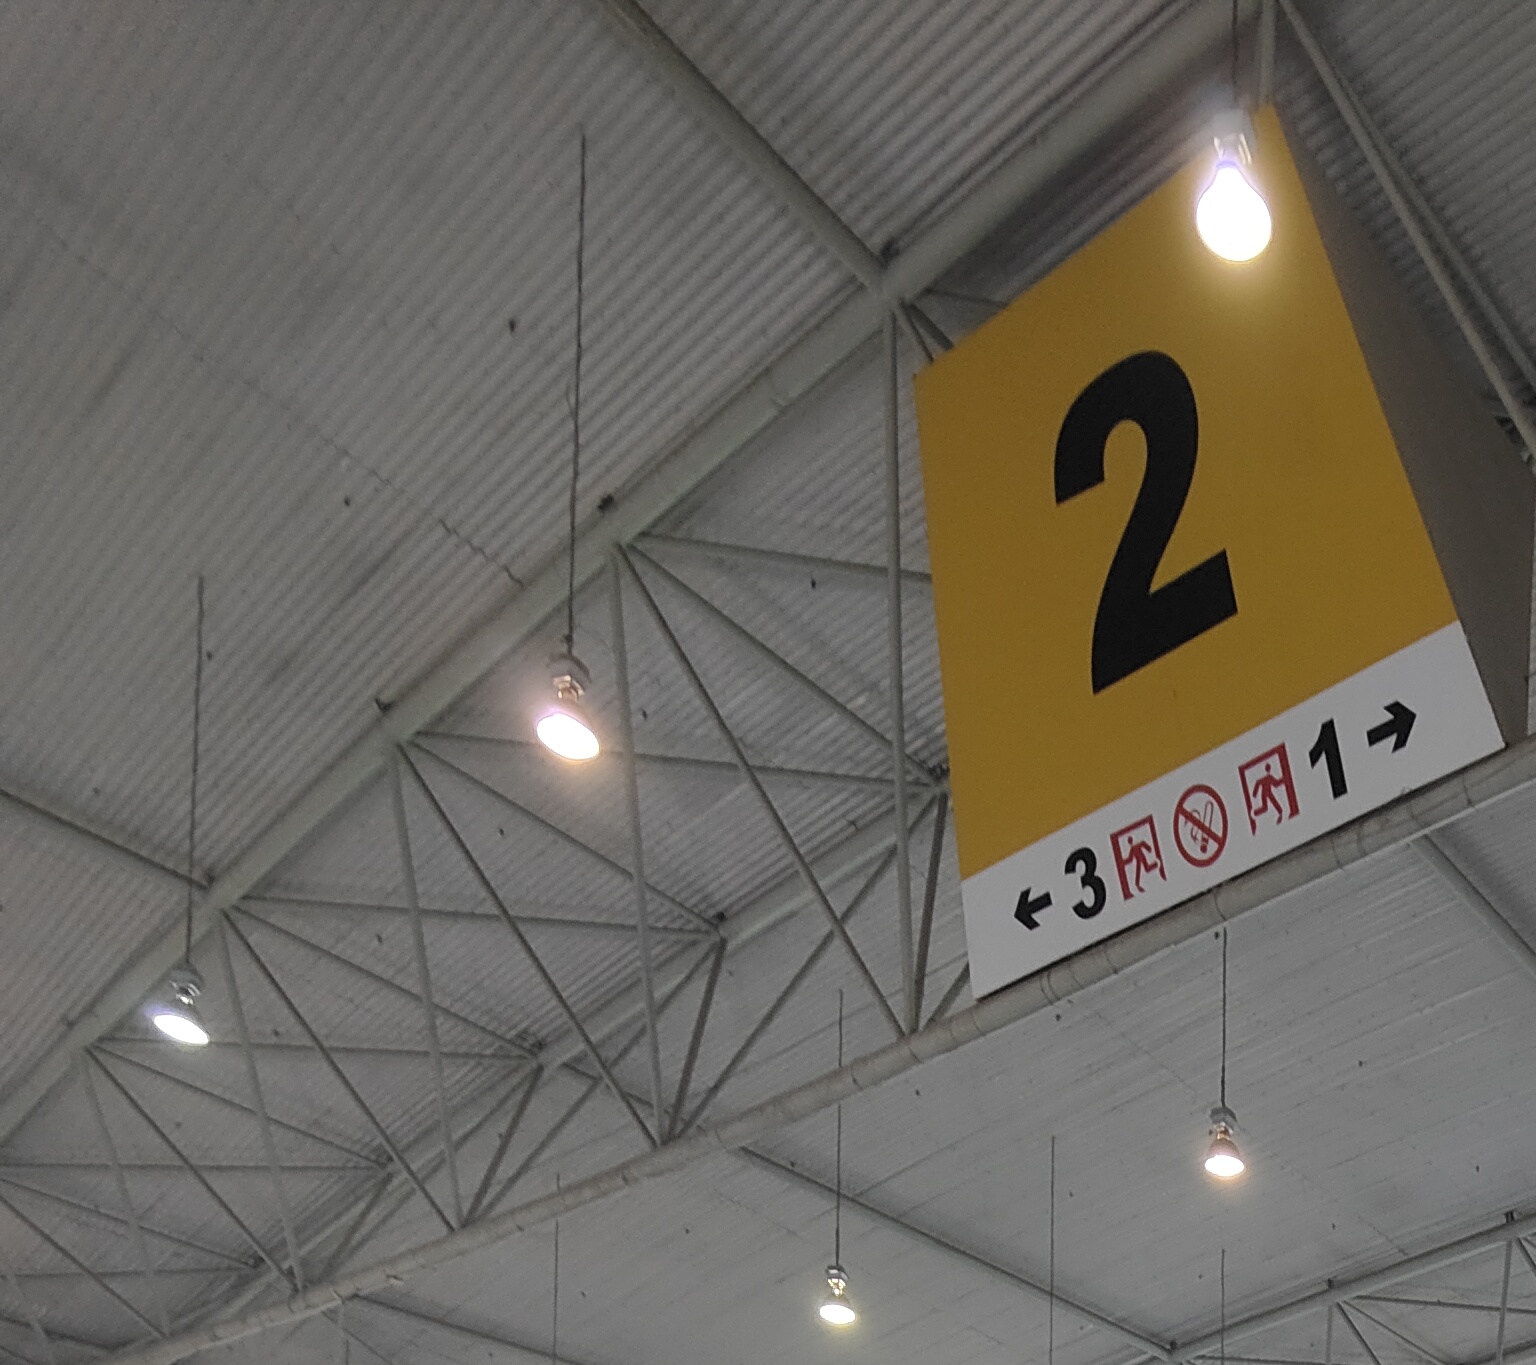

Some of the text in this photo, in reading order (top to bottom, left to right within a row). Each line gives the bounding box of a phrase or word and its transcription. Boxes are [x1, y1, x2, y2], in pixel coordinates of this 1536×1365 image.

[1054, 349, 1239, 696] 2
[1063, 718, 1348, 920] 3 1
